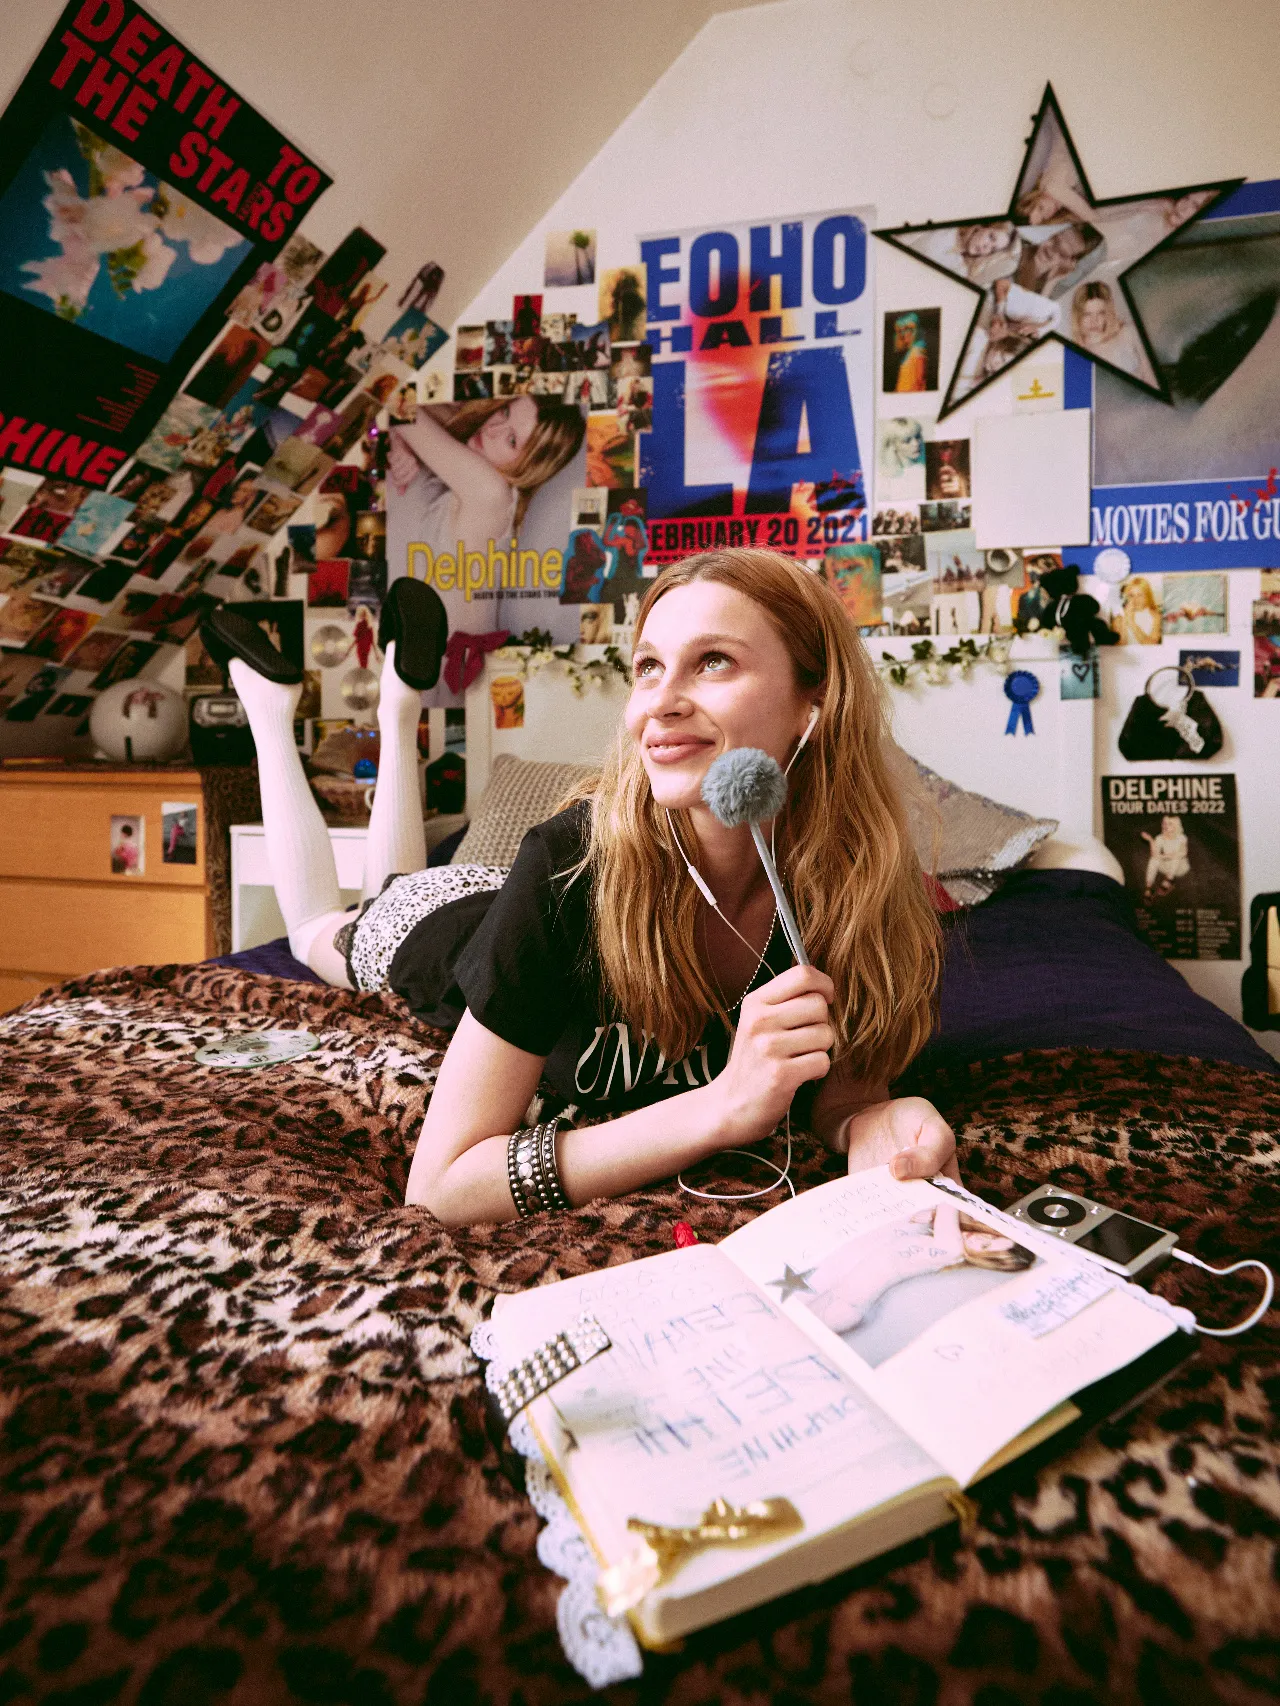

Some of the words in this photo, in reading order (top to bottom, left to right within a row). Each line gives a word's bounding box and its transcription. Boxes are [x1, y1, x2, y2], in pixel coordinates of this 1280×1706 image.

[72, 0, 241, 141] DEATH
[267, 144, 321, 205] TO
[50, 31, 158, 142] THE
[169, 132, 294, 242] STARS
[646, 310, 861, 354] HALL
[0, 410, 127, 485] HINE
[640, 346, 867, 519] LA
[646, 520, 759, 552] EBRUARY
[768, 517, 799, 546] 20
[806, 514, 868, 544] 2021
[1091, 503, 1190, 546] MOVIES
[1194, 500, 1250, 542] FOR
[407, 538, 563, 603] Delphine
[1109, 778, 1223, 801] DELPHINE
[1111, 802, 1144, 814] TOUR
[1146, 802, 1189, 814] DATES
[1192, 801, 1226, 814] 2022
